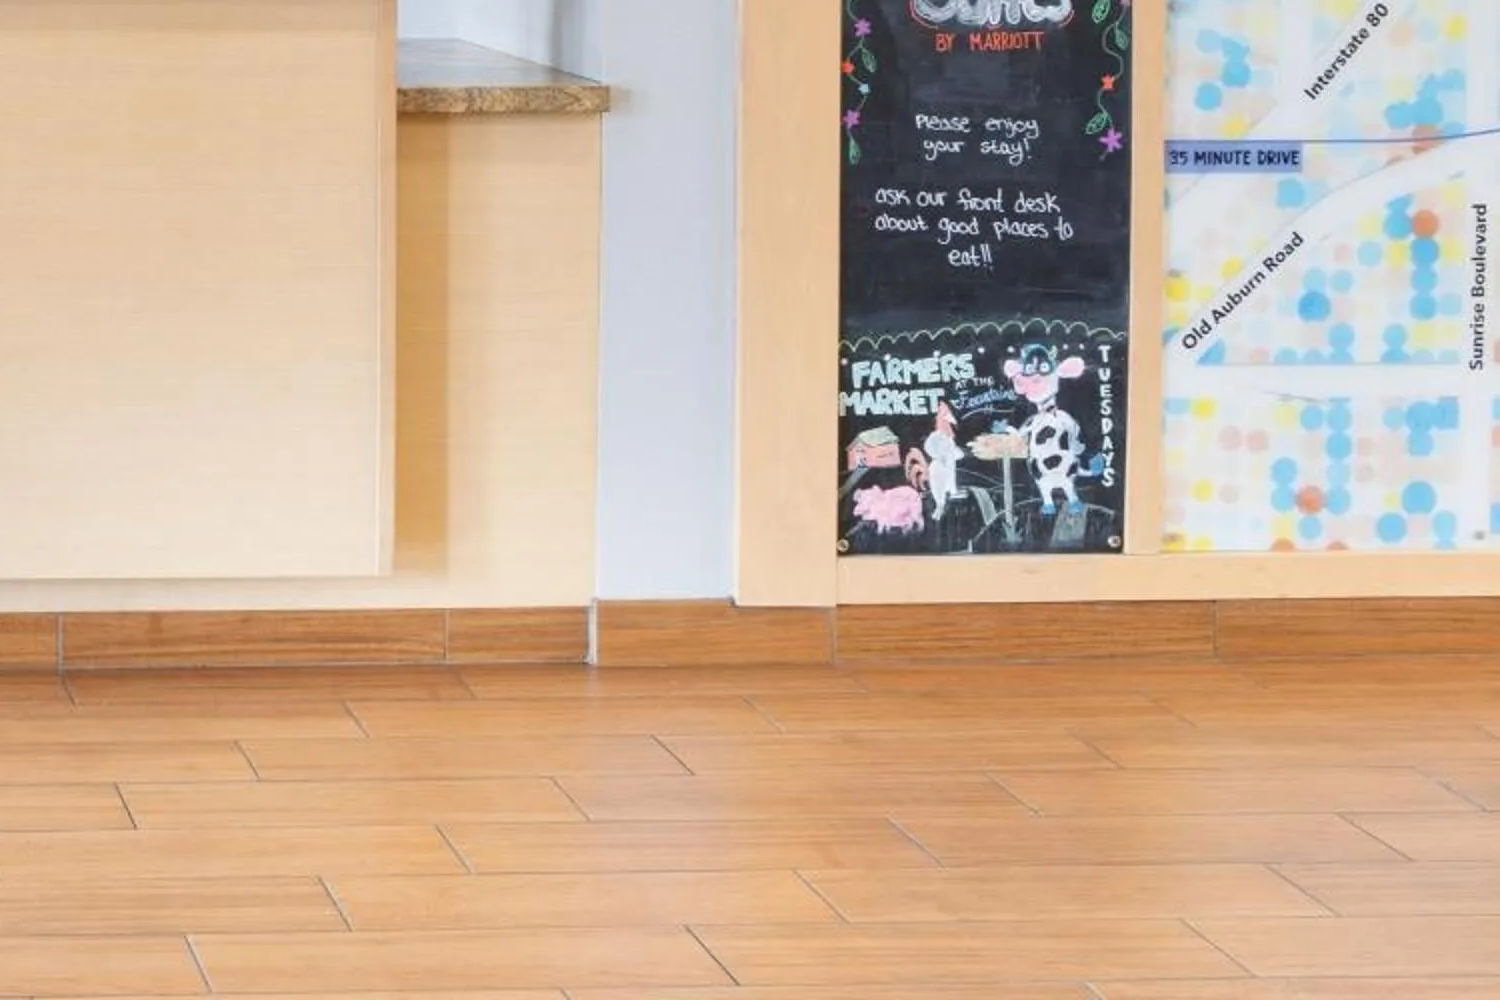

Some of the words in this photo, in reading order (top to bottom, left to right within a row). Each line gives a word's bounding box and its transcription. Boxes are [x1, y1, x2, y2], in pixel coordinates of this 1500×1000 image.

[935, 32, 955, 52] BY
[969, 31, 1045, 51] MARRIOTT
[1304, 24, 1371, 101] Interstate
[1364, 2, 1390, 30] 80
[915, 113, 971, 133] Please
[985, 117, 1040, 139] enjoy
[923, 139, 964, 161] your
[980, 137, 1033, 166] stay!
[1169, 150, 1190, 167] 35
[1193, 150, 1252, 167] MINUTE
[1256, 150, 1300, 167] DRIVE
[875, 188, 910, 206] ask
[916, 190, 948, 207] our
[956, 187, 1005, 213] front
[1014, 191, 1061, 213] desk
[875, 213, 928, 232] about
[937, 216, 979, 245] good
[993, 216, 1049, 241] places
[1053, 216, 1074, 241] to
[947, 244, 994, 271] eat!!
[1470, 203, 1489, 299] Boulevard
[1182, 321, 1212, 351] Old
[1210, 267, 1266, 326] Auburn
[1262, 231, 1306, 279] Road
[1469, 303, 1485, 371] Sunrise
[851, 353, 976, 388] FARMERS
[955, 378, 969, 391] AT
[972, 375, 995, 388] THE
[838, 387, 945, 417] MARKET
